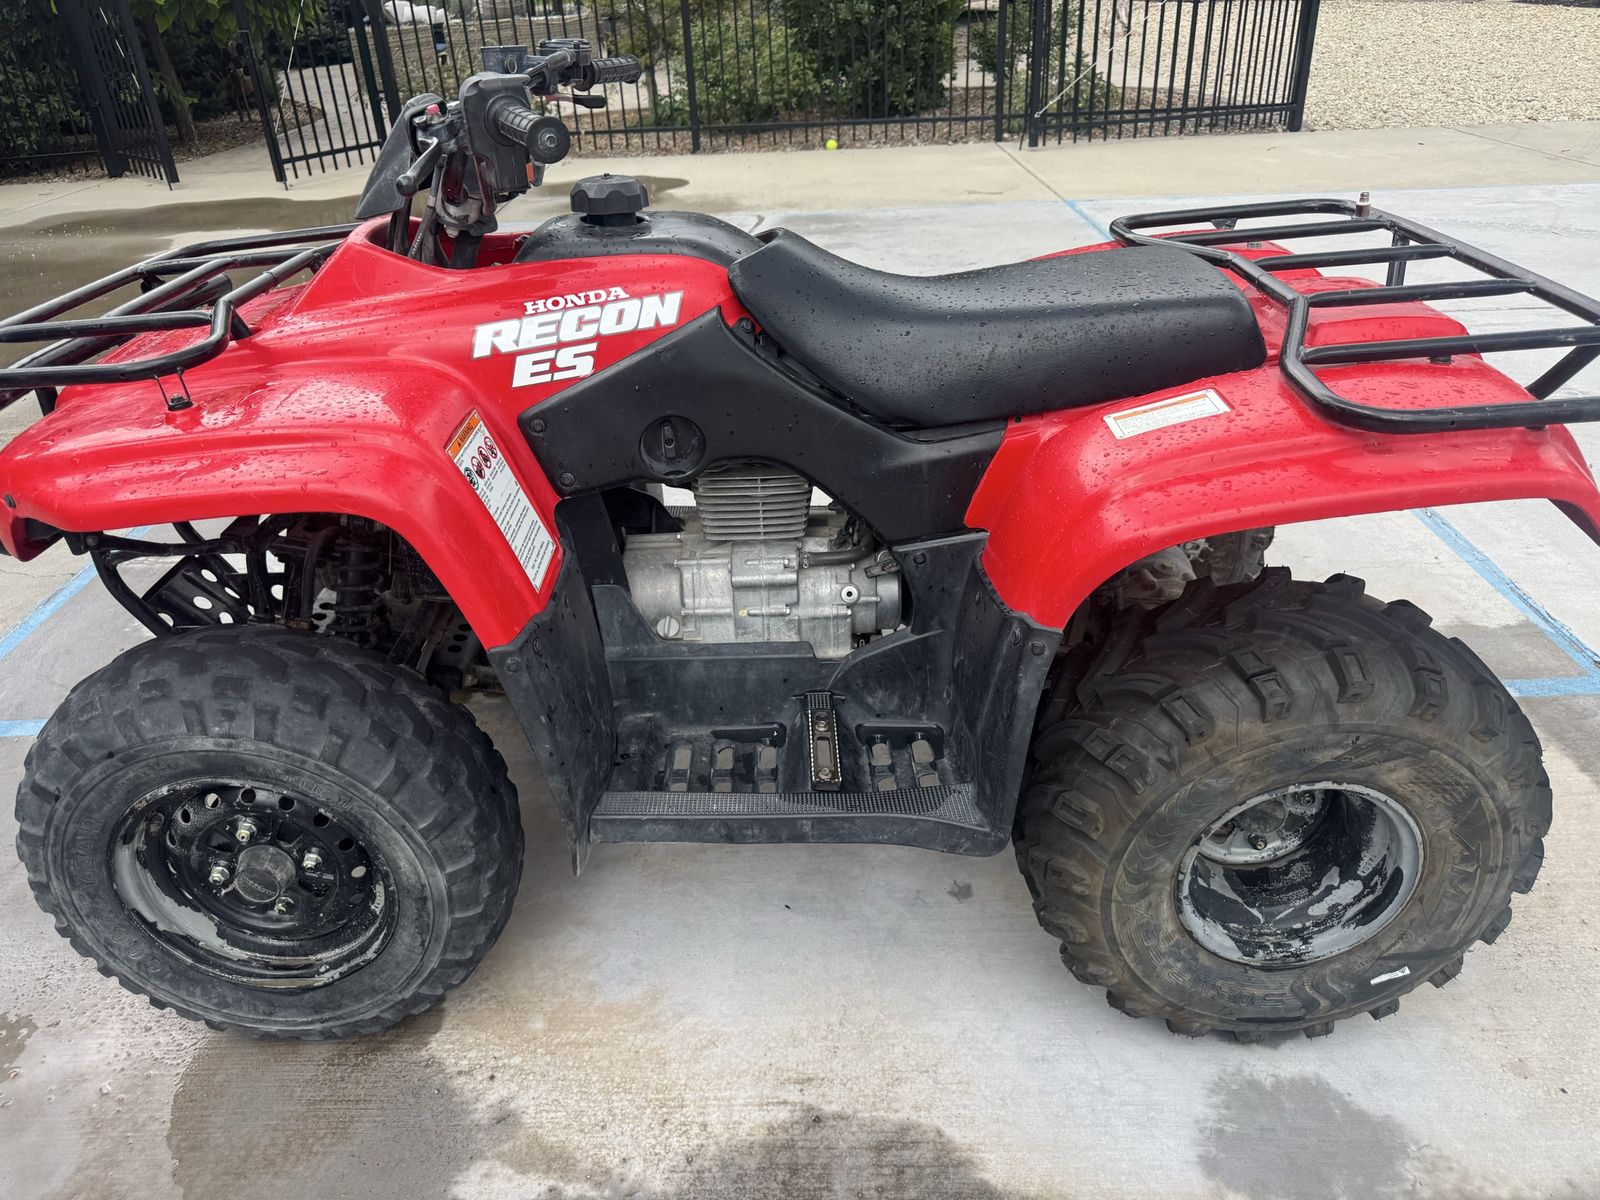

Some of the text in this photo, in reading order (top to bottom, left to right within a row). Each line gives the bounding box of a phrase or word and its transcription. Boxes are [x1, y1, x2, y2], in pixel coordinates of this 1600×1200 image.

[523, 286, 630, 315] HONDA
[472, 290, 683, 359] RECON
[511, 342, 598, 388] ES
